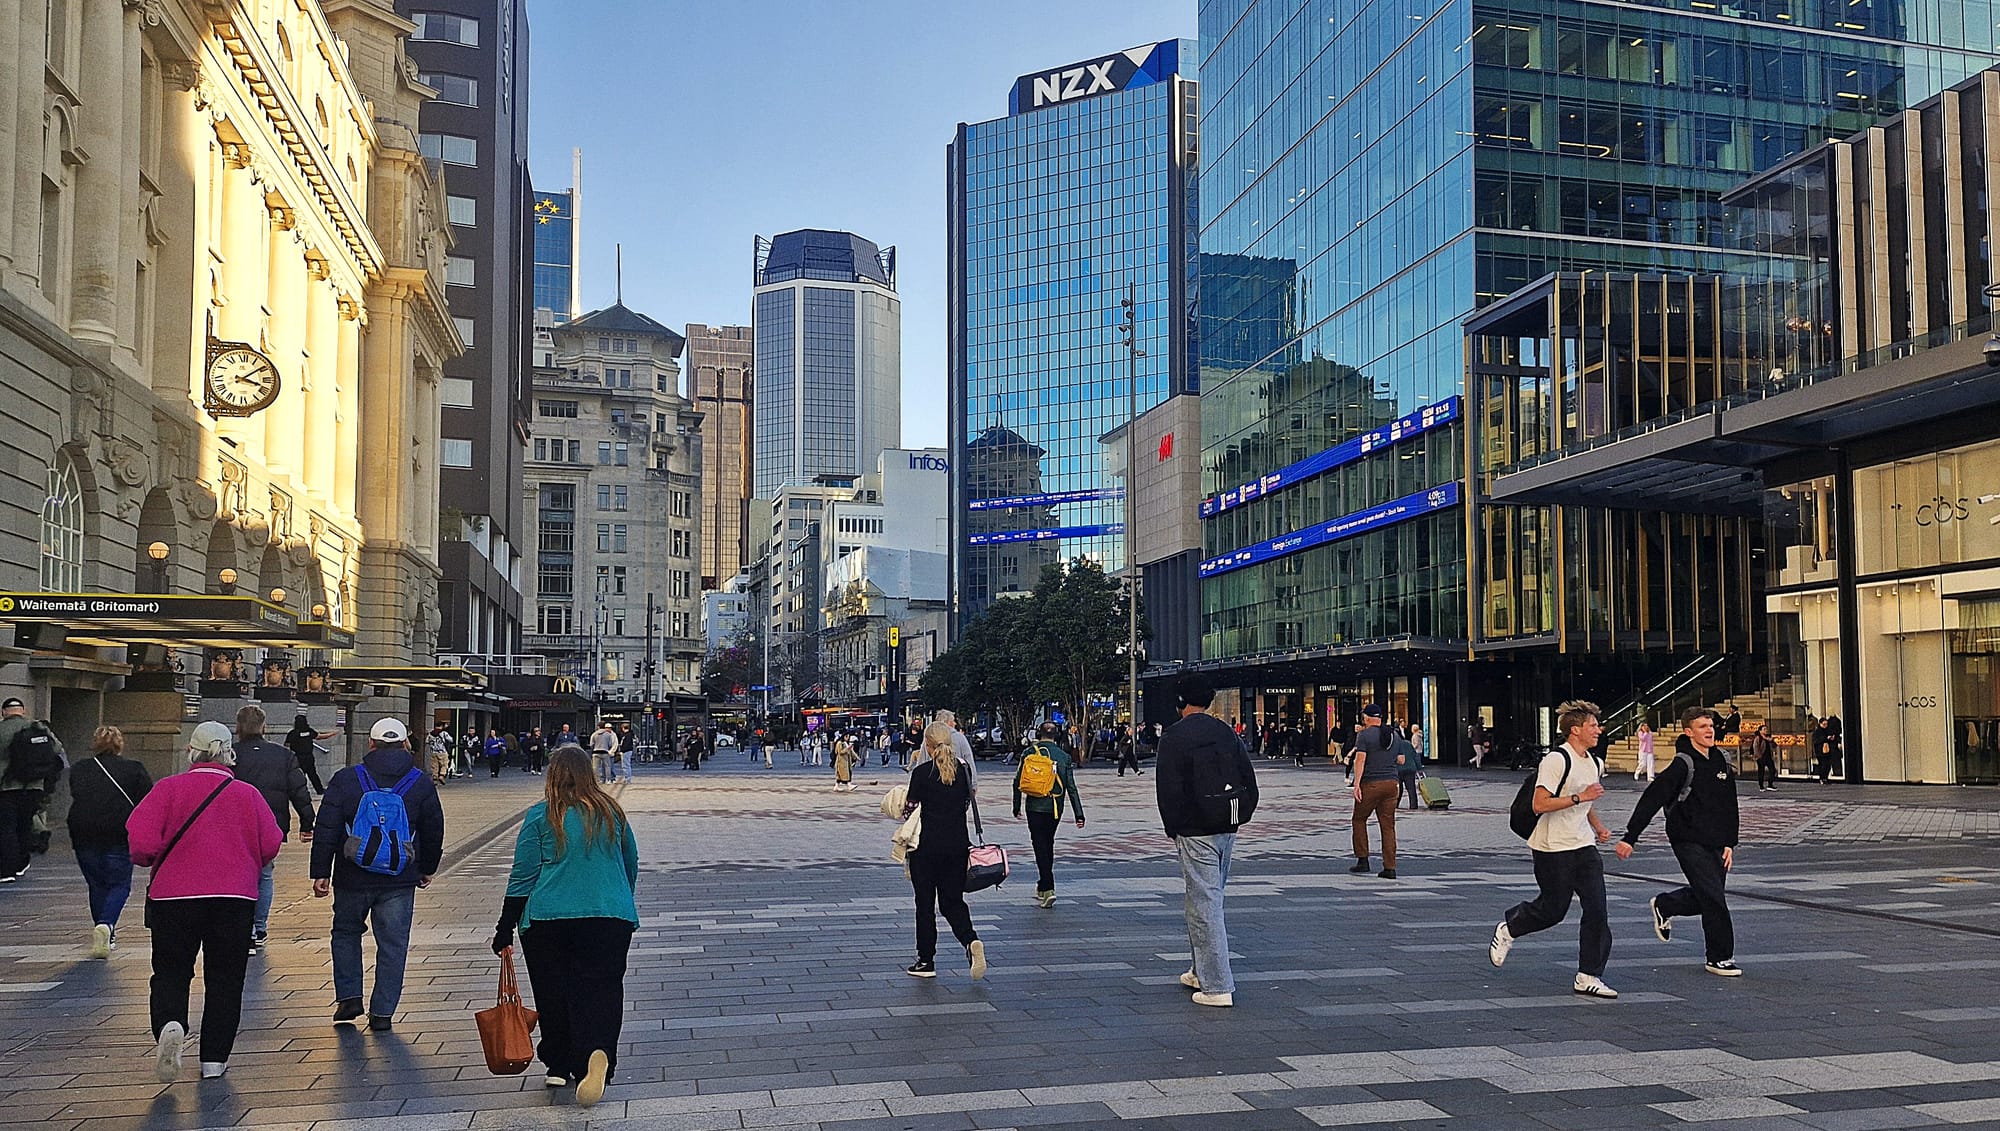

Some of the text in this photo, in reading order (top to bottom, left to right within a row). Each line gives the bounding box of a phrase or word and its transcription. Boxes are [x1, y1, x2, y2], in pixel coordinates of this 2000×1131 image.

[1033, 59, 1116, 107] NZX
[1915, 498, 1970, 526] COS
[19, 599, 160, 613] Waitematā (Britomart)
[1319, 684, 1337, 692] COACH
[1910, 696, 1937, 708] COS
